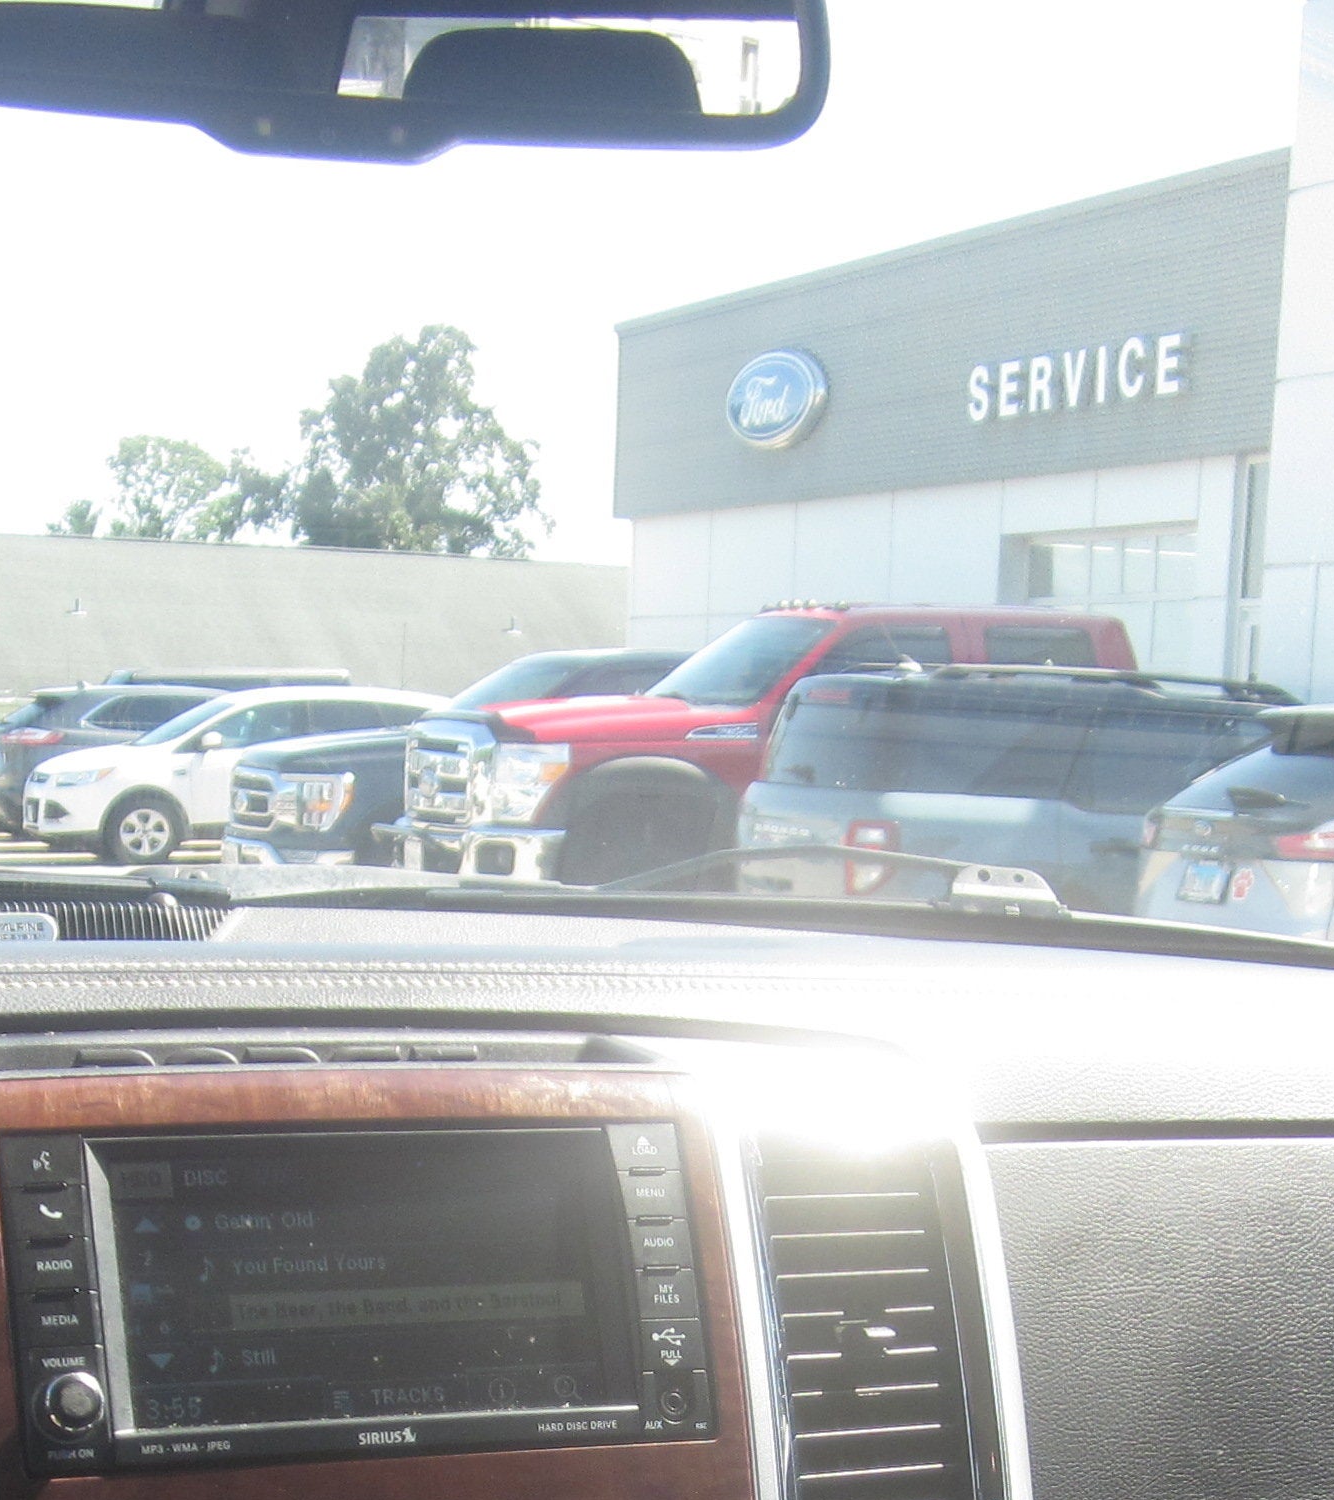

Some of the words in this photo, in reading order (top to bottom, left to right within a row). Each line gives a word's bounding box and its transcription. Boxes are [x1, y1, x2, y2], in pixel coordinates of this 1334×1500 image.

[969, 332, 1183, 421] SERVICE
[739, 375, 791, 428] Ford
[183, 1169, 228, 1187] DISC
[636, 1188, 665, 1198] MENU
[644, 1236, 675, 1247] AUDIO
[36, 1259, 73, 1272] RADIO
[232, 1256, 267, 1275] You
[272, 1254, 328, 1275] Found
[333, 1252, 386, 1272] Yours
[654, 1293, 680, 1304] FILES
[41, 1314, 79, 1327] MEDIA
[660, 1349, 682, 1359] PULL
[41, 1356, 86, 1368] VOLUME
[371, 1387, 446, 1407] TRACKS
[537, 1422, 564, 1433] HARD
[566, 1421, 589, 1431] DISC
[591, 1419, 618, 1430] DRIVE
[644, 1419, 665, 1431] AUX
[358, 1430, 403, 1446] SIRIUS
[141, 1443, 164, 1455] MP3
[171, 1442, 199, 1453] WMA
[206, 1440, 231, 1451] JPEG
